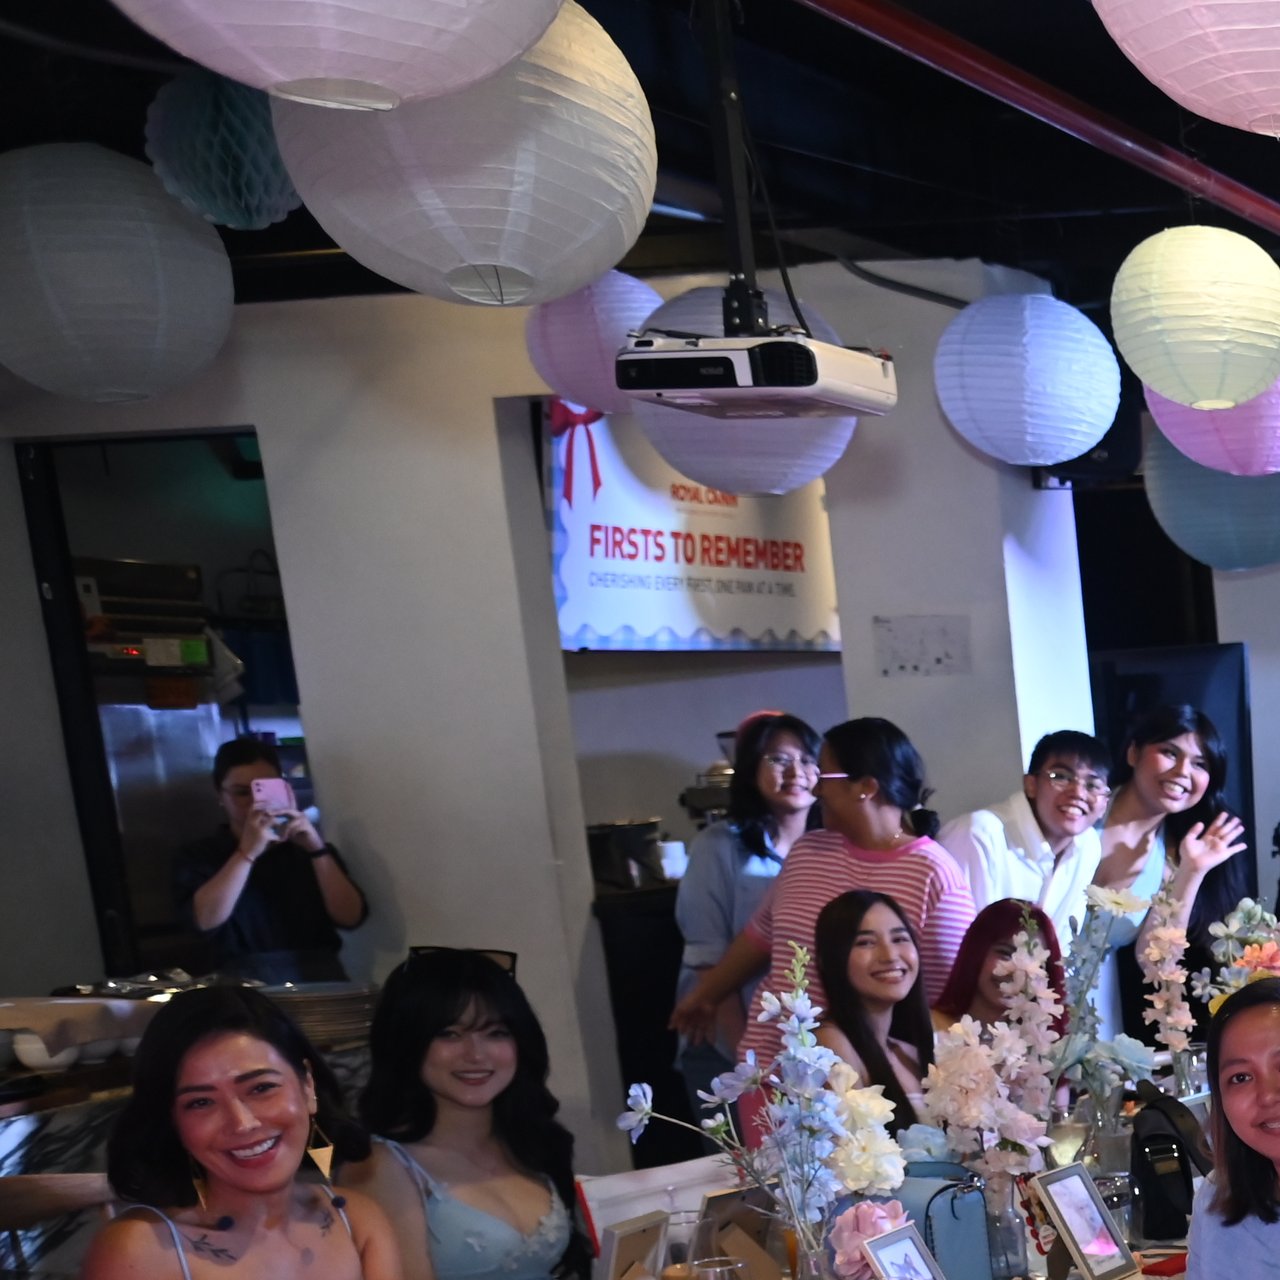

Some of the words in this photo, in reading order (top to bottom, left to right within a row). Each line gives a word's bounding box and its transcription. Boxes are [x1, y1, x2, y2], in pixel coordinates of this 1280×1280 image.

[671, 483, 703, 505] ROYAL
[589, 523, 667, 563] FIRSTS
[670, 531, 696, 565] TO
[700, 533, 805, 573] REMEMBER
[588, 571, 651, 590] CHERISHING
